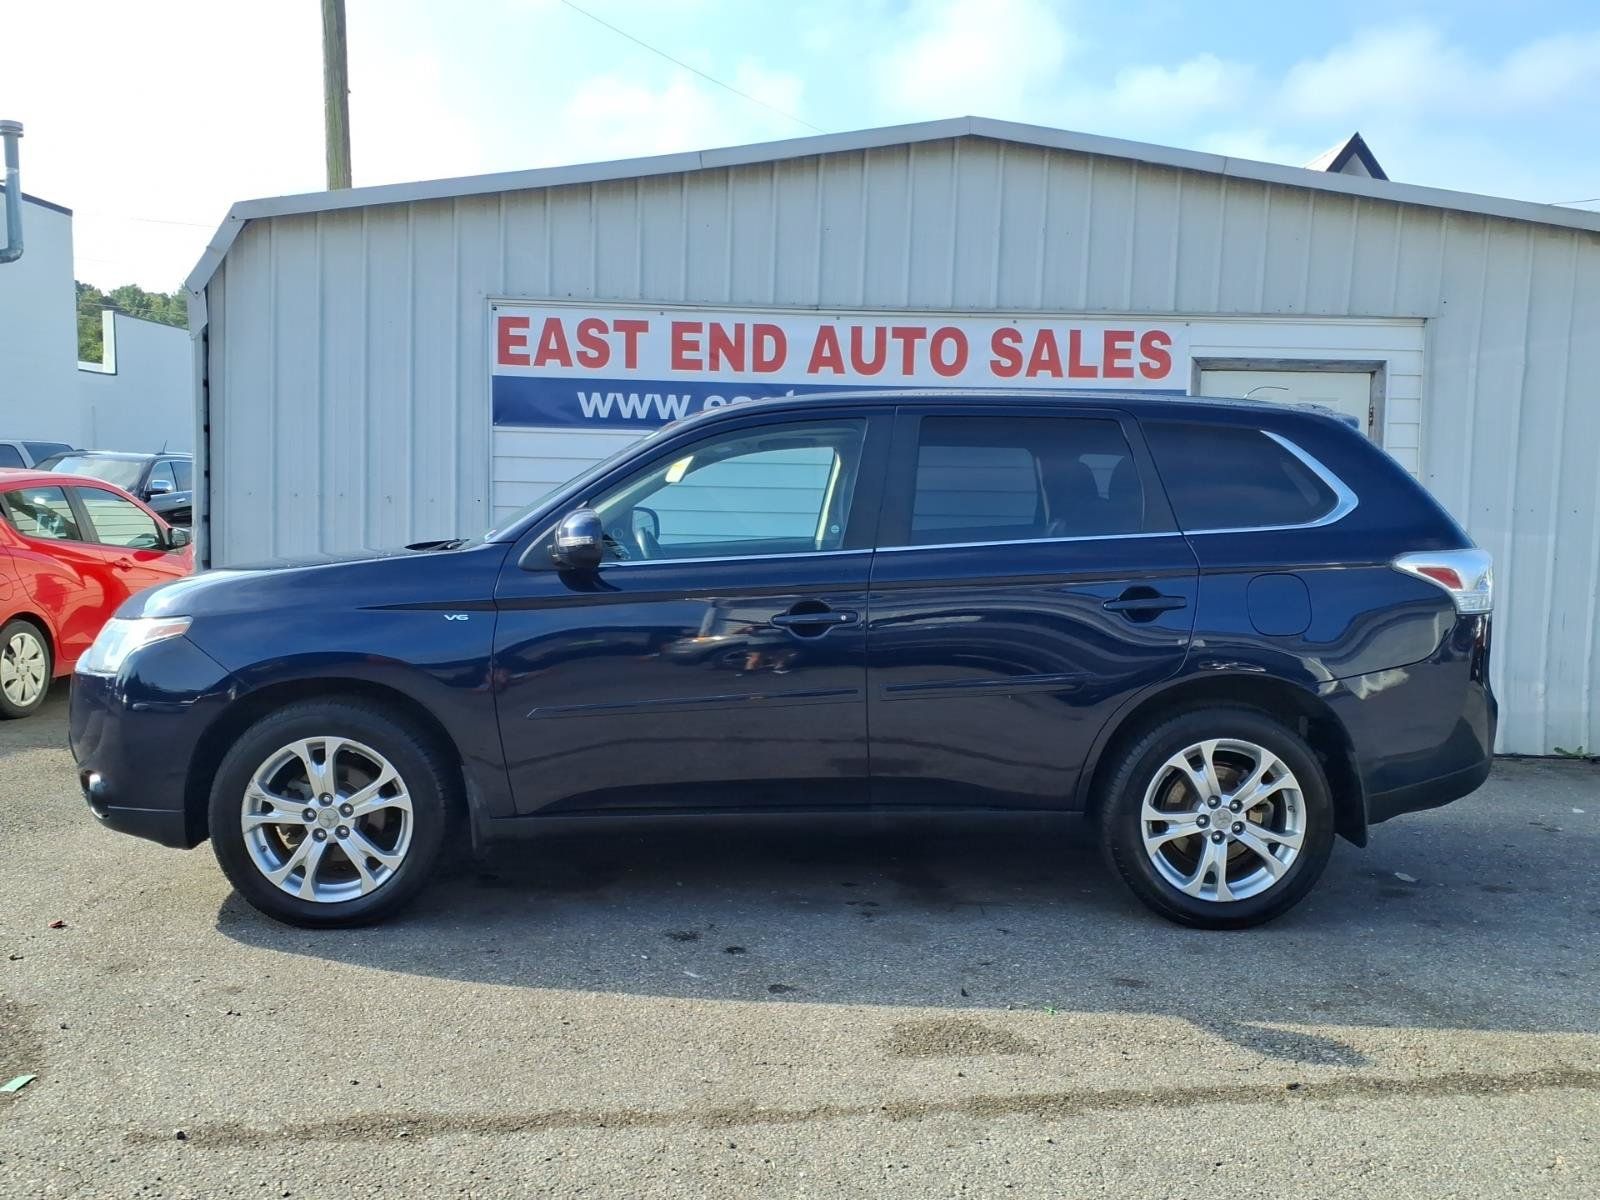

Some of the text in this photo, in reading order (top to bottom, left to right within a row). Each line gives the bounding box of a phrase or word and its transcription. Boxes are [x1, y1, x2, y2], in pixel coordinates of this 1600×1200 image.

[497, 316, 1172, 379] EAST END AUTO SALES
